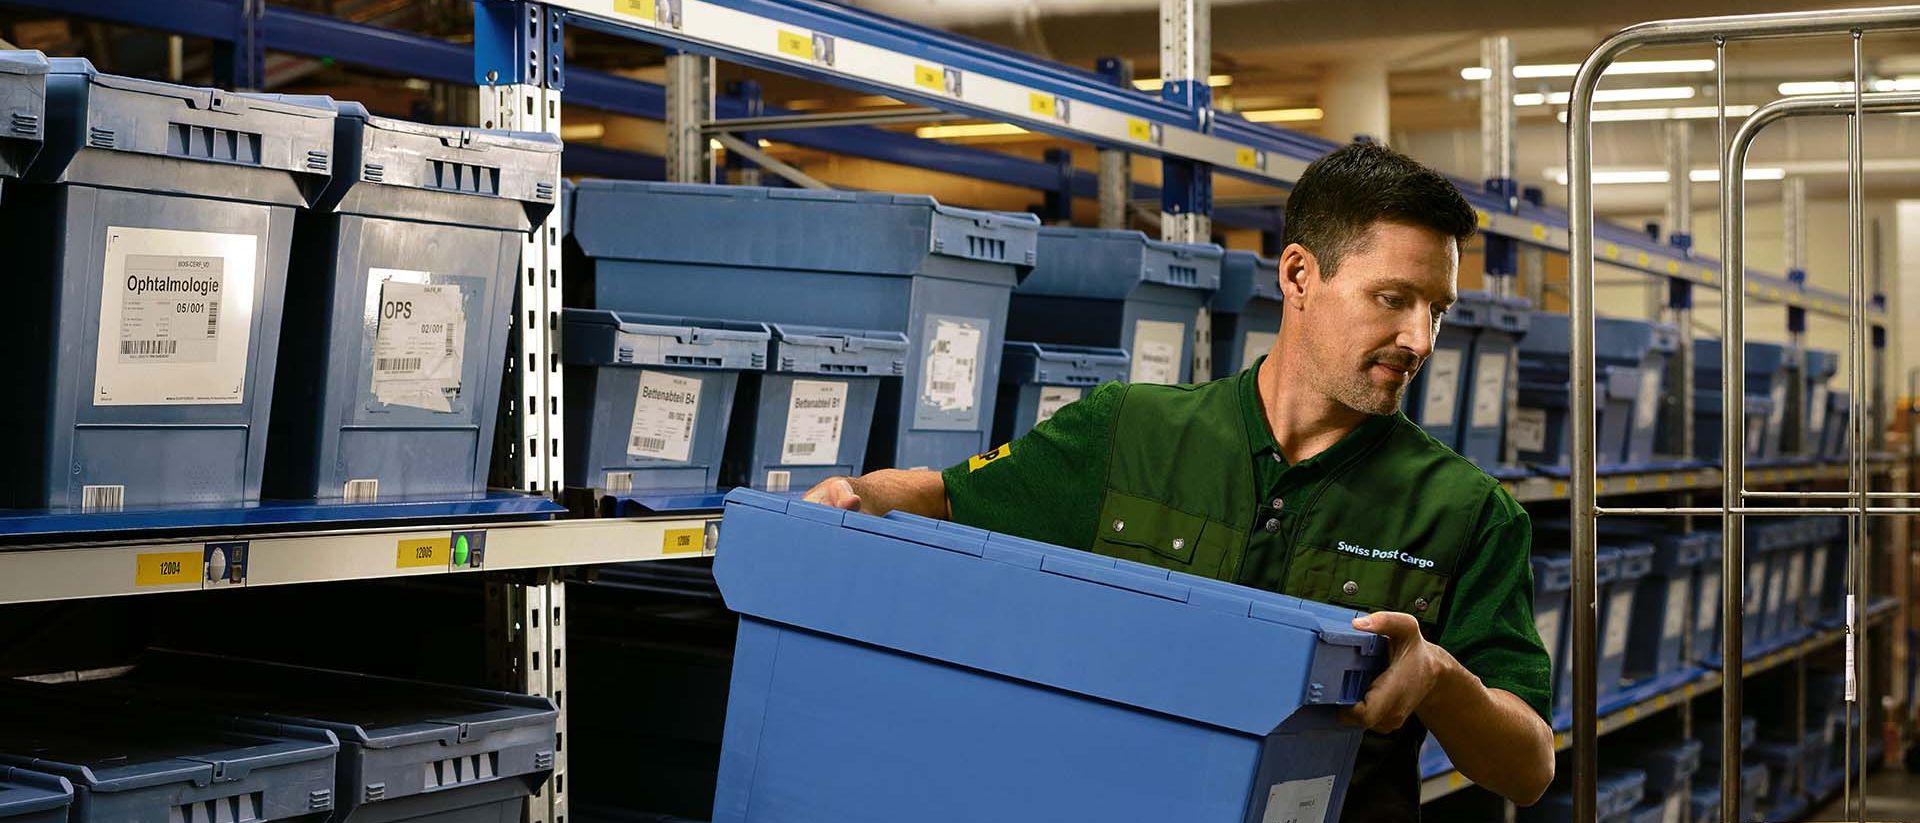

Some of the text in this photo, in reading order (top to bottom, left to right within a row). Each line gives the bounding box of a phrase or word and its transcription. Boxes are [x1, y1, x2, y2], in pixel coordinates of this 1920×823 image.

[127, 275, 219, 295] Ophtalmologie
[176, 302, 205, 313] 05/001
[384, 301, 412, 319] OPS
[421, 324, 443, 334] 02/001
[642, 386, 696, 404] Bettenabteil B4
[795, 397, 831, 408] Bettenabteil
[416, 546, 432, 559] 12005
[1337, 541, 1434, 568] Swiss Post Cargo
[159, 561, 180, 575] 12004
